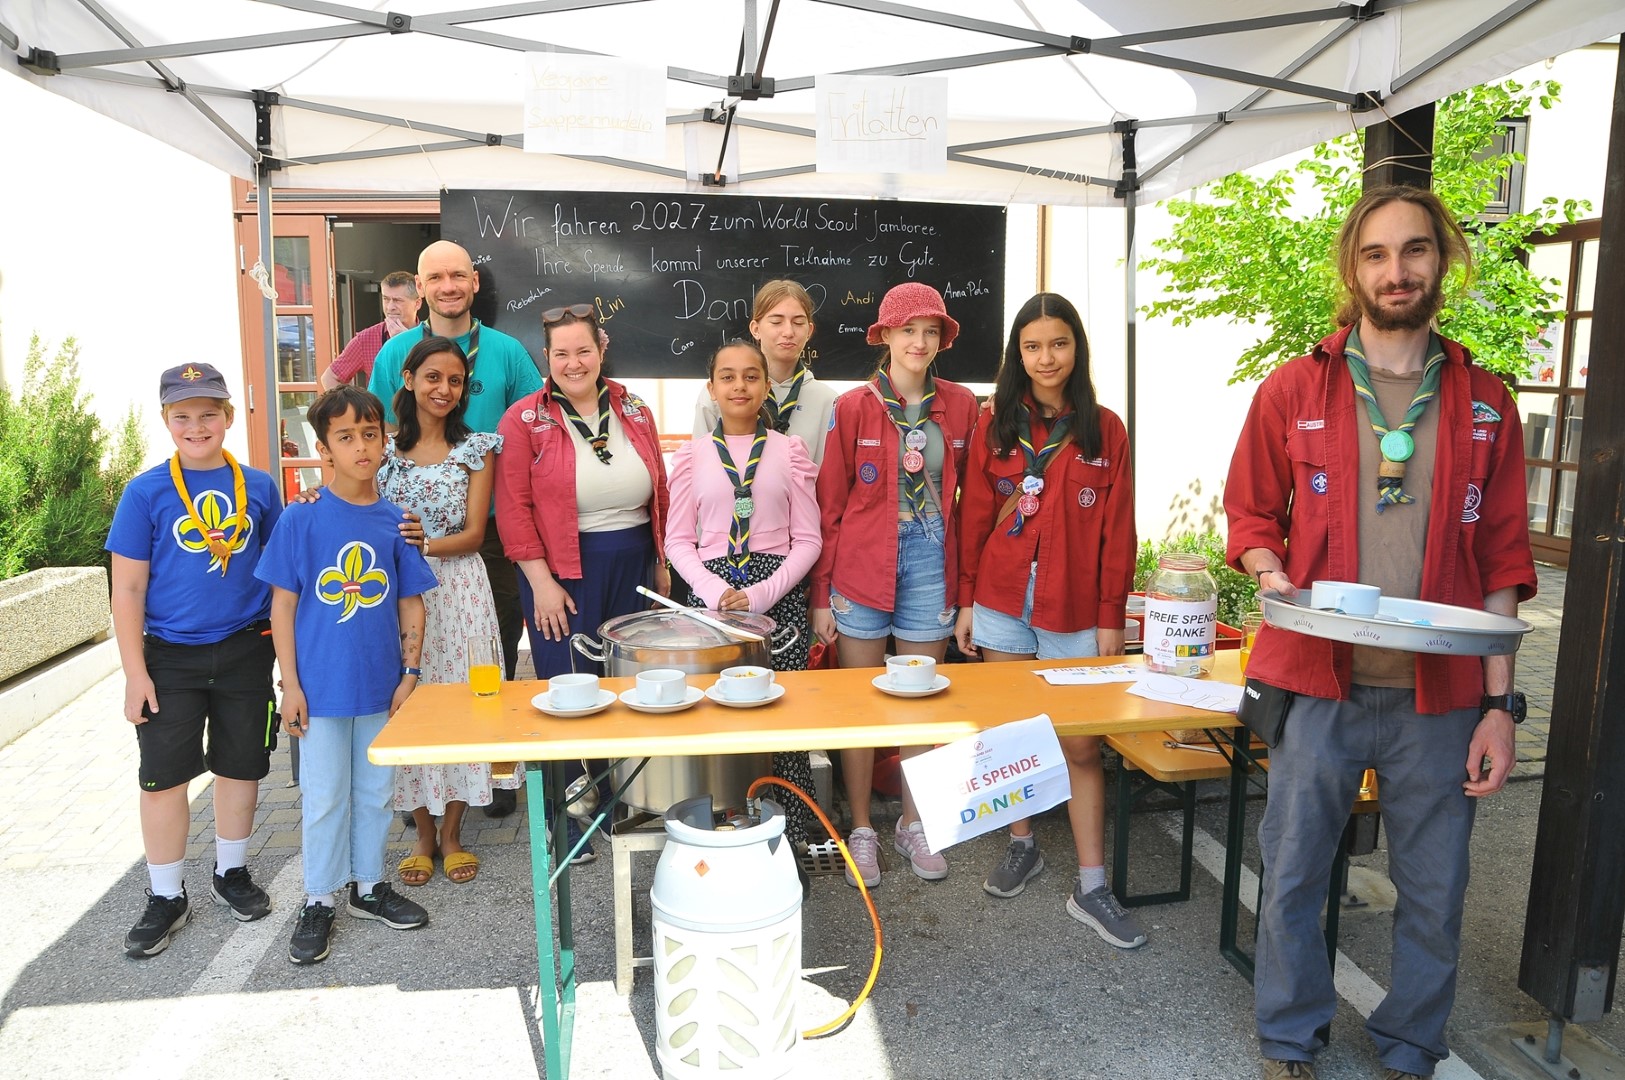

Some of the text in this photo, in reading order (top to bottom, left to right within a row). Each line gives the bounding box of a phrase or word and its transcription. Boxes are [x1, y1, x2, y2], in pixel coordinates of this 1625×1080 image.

[531, 64, 609, 103] Vegane
[827, 87, 939, 138] Fritatten
[473, 195, 535, 238] Wir
[551, 203, 621, 247] fahren
[630, 201, 705, 231] 2027
[709, 214, 754, 231] zum
[758, 200, 808, 231] World
[815, 203, 858, 231] Scout
[535, 248, 572, 275] Ihre
[583, 249, 624, 282] Spende
[651, 245, 702, 273] kommt
[716, 256, 770, 269] unserer
[780, 244, 852, 267] Teilnahme
[868, 254, 888, 267] zu
[506, 286, 552, 313] Rebekka
[840, 290, 875, 305] Andi
[838, 323, 865, 334] Emma
[670, 337, 695, 356] Caro
[1149, 610, 1179, 624] FREIE
[1165, 627, 1206, 638] DANKE
[982, 754, 1041, 787] SPENDE
[959, 784, 1036, 824] DANKE
